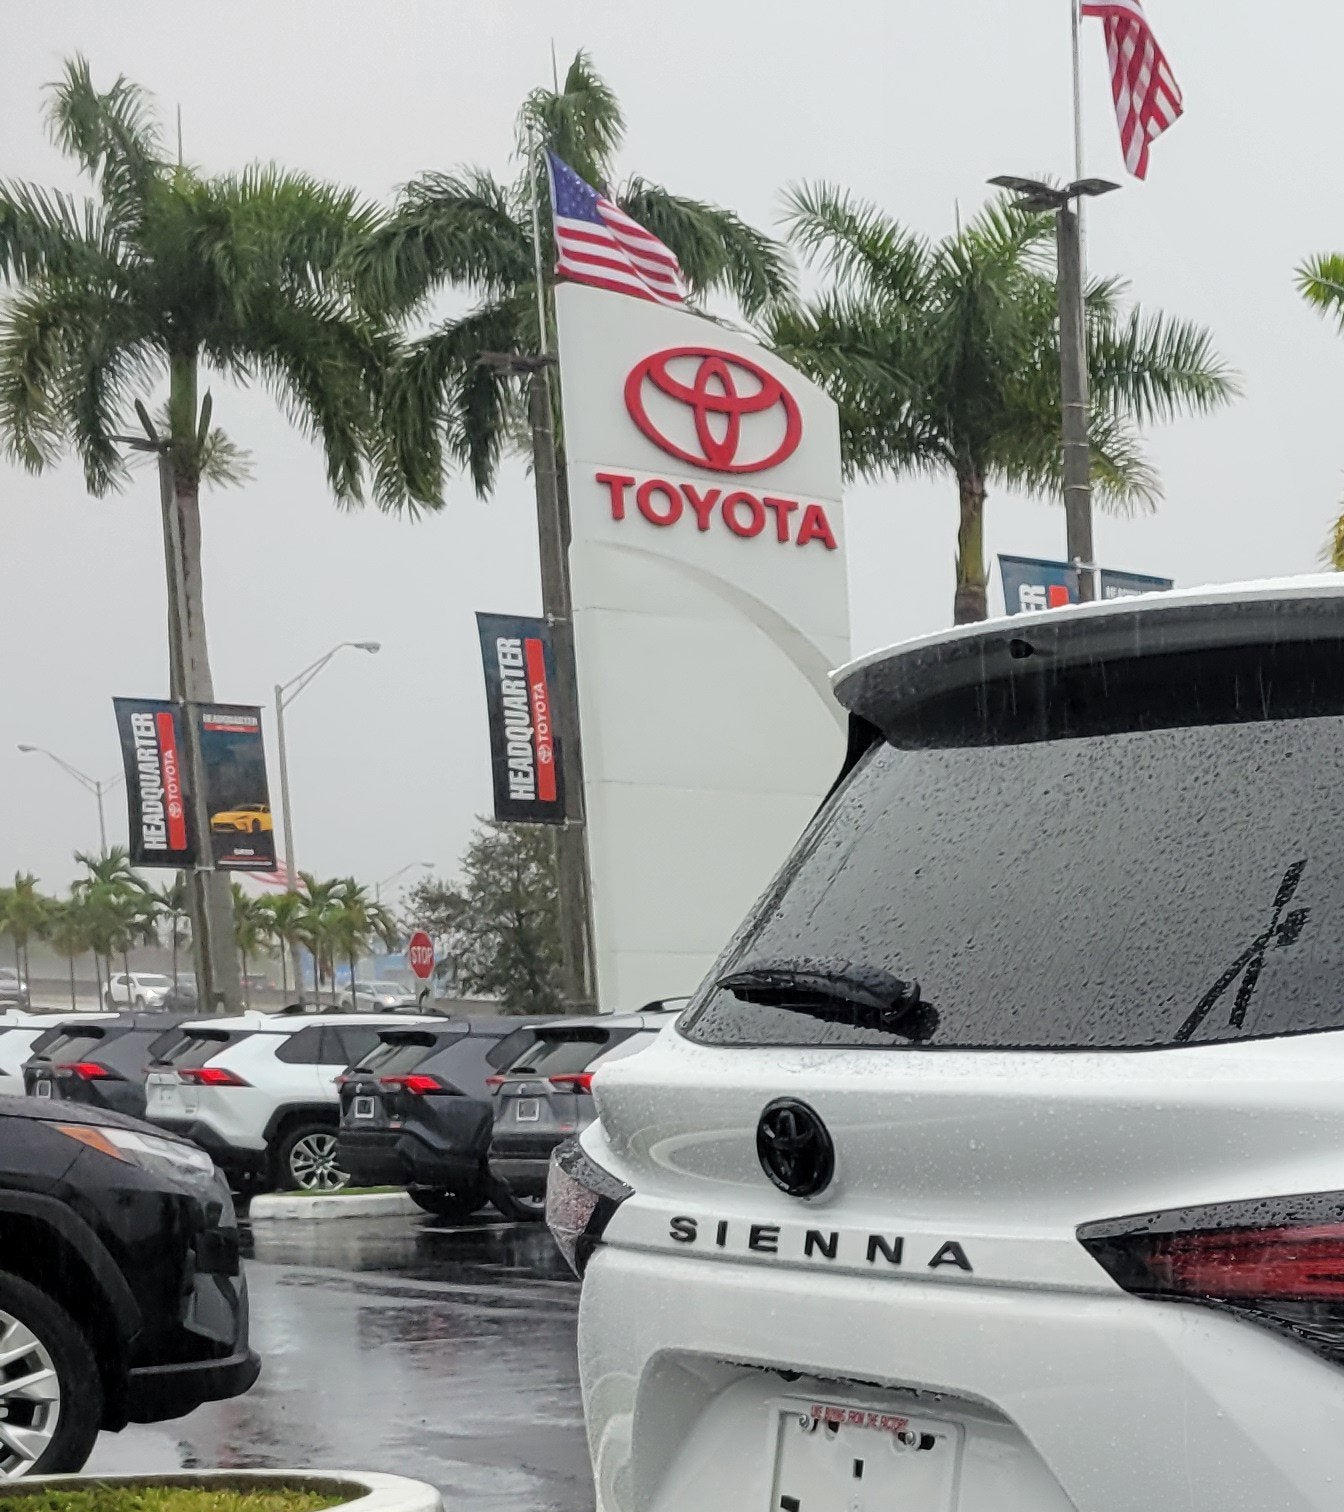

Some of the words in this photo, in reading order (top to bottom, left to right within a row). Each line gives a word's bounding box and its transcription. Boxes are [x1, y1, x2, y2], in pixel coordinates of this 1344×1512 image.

[596, 473, 838, 551] TOYOTA
[496, 637, 536, 801] HEADQUARTER
[533, 682, 550, 742] TOYOTA
[131, 712, 167, 850] HEADQUARTER
[164, 749, 179, 800] TOYOTA
[410, 945, 433, 965] STOP
[669, 1216, 974, 1272] SIENNA
